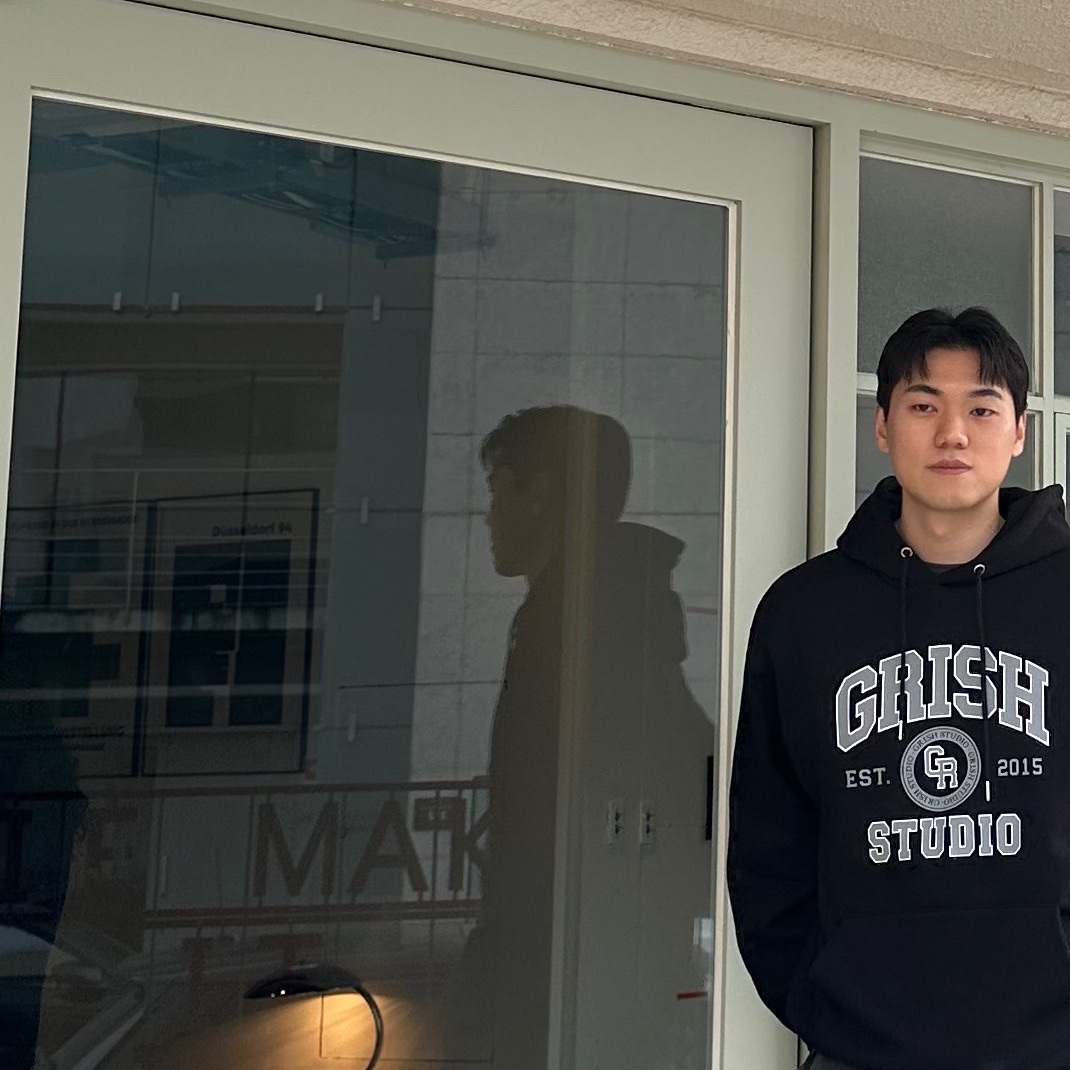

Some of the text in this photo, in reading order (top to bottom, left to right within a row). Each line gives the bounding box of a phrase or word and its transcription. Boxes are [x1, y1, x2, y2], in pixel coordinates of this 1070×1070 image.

[835, 644, 1050, 753] GRISH
[913, 731, 969, 751] GRISH STUDIO
[845, 767, 891, 788] EST.
[906, 756, 940, 806] GRISH STUDIO
[923, 745, 958, 790] GR
[944, 751, 976, 806] GRISH STUDIO
[997, 758, 1043, 777] 2015
[867, 813, 1021, 864] STUDIO
